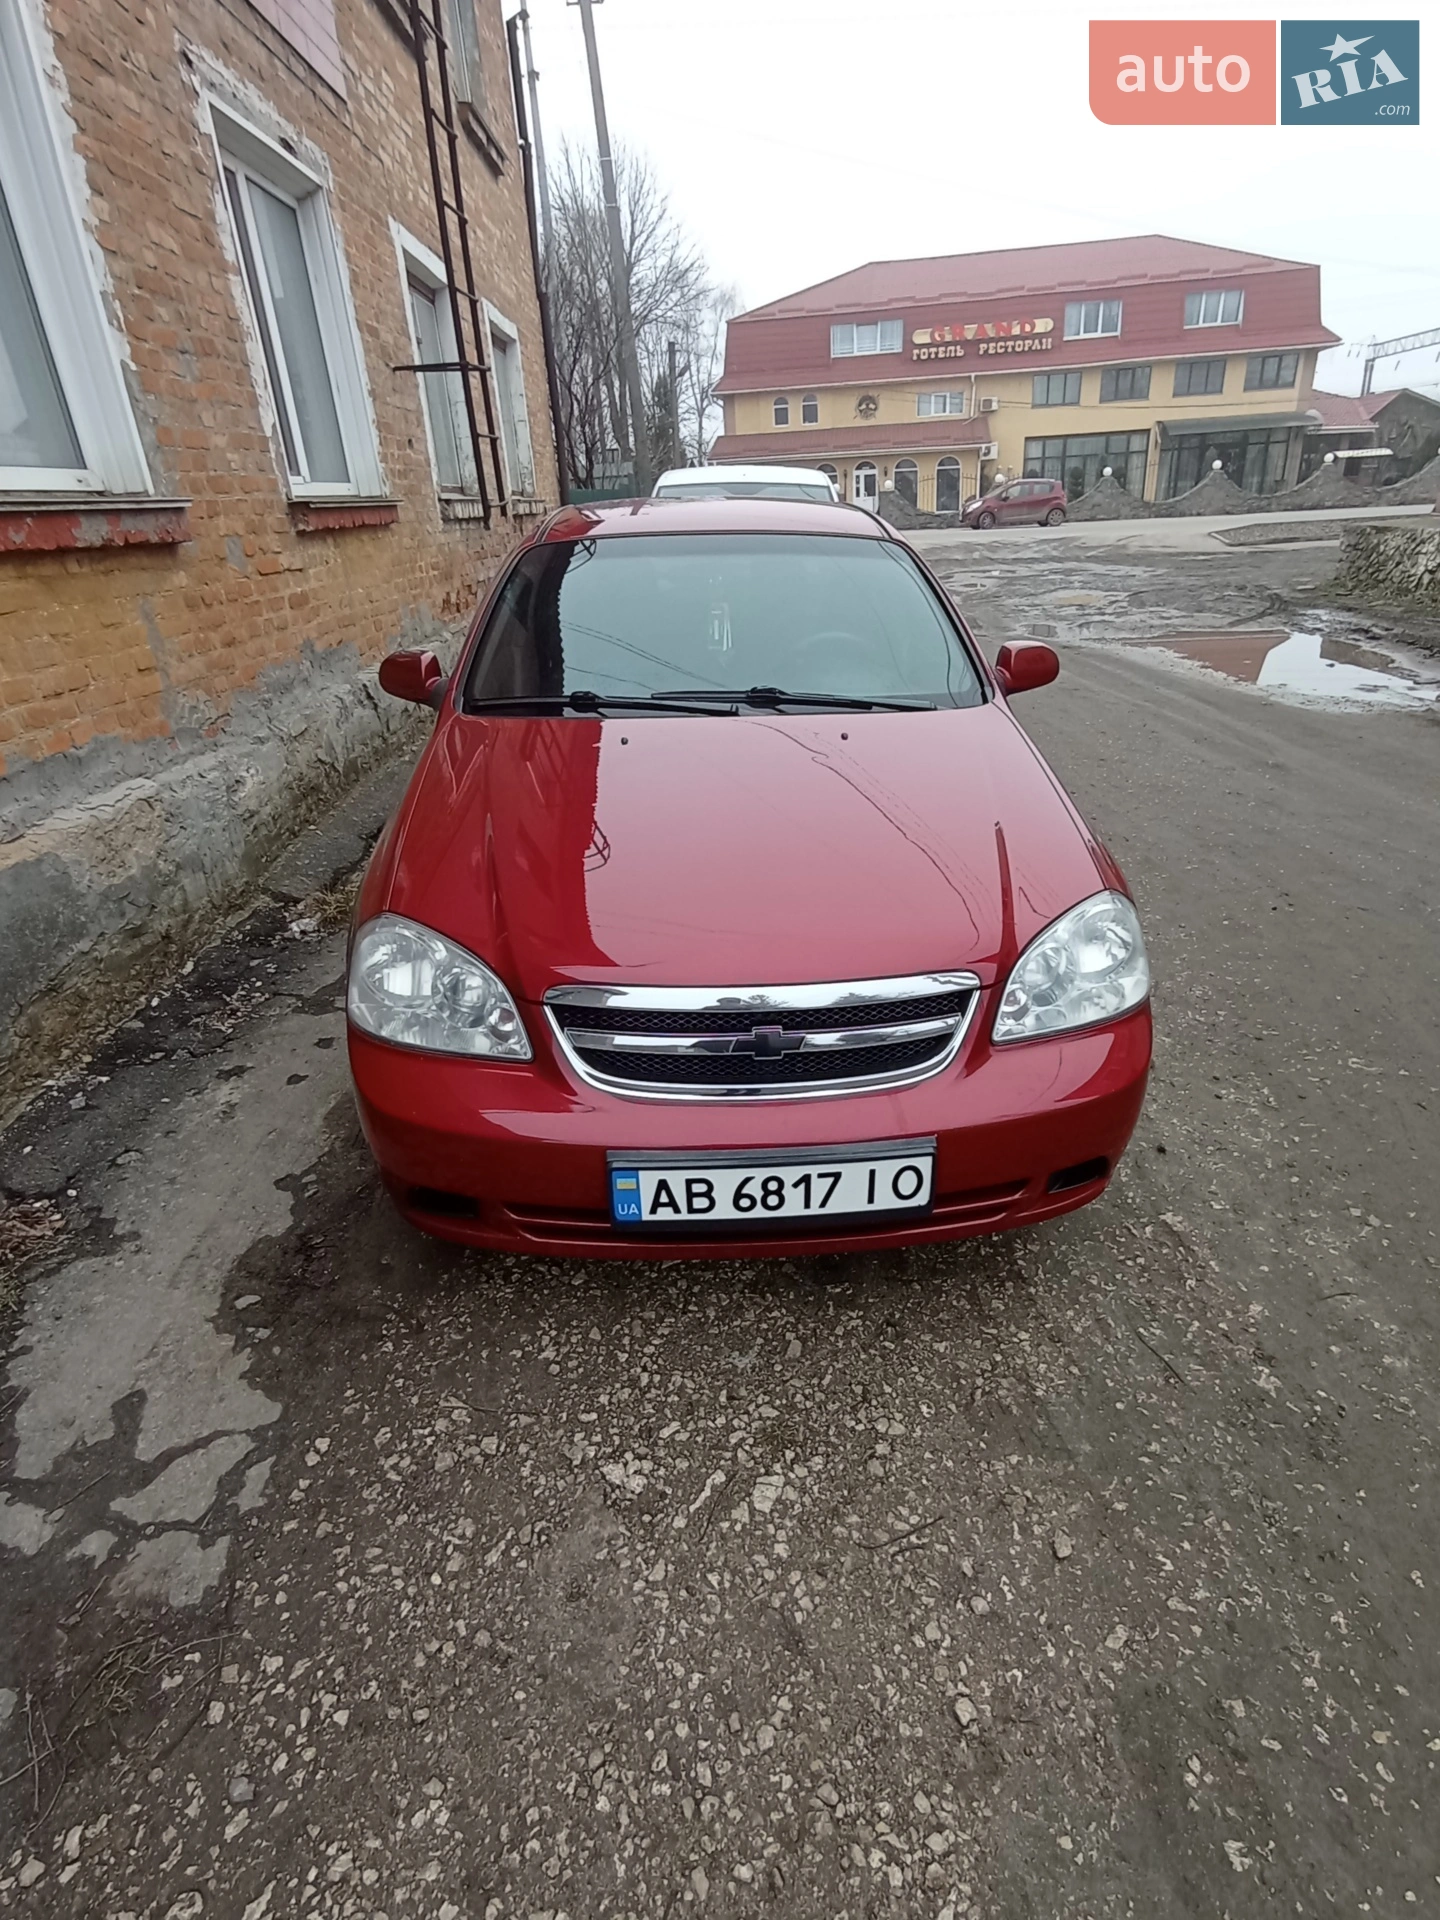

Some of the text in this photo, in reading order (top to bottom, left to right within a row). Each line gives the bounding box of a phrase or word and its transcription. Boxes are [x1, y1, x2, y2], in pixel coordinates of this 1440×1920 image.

[930, 317, 1036, 344] GRAND
[912, 338, 1052, 361] ГОТЕЛЬ РЕСТОРАН
[648, 1164, 924, 1215] AB 6817 IO
[617, 1203, 640, 1215] UA
